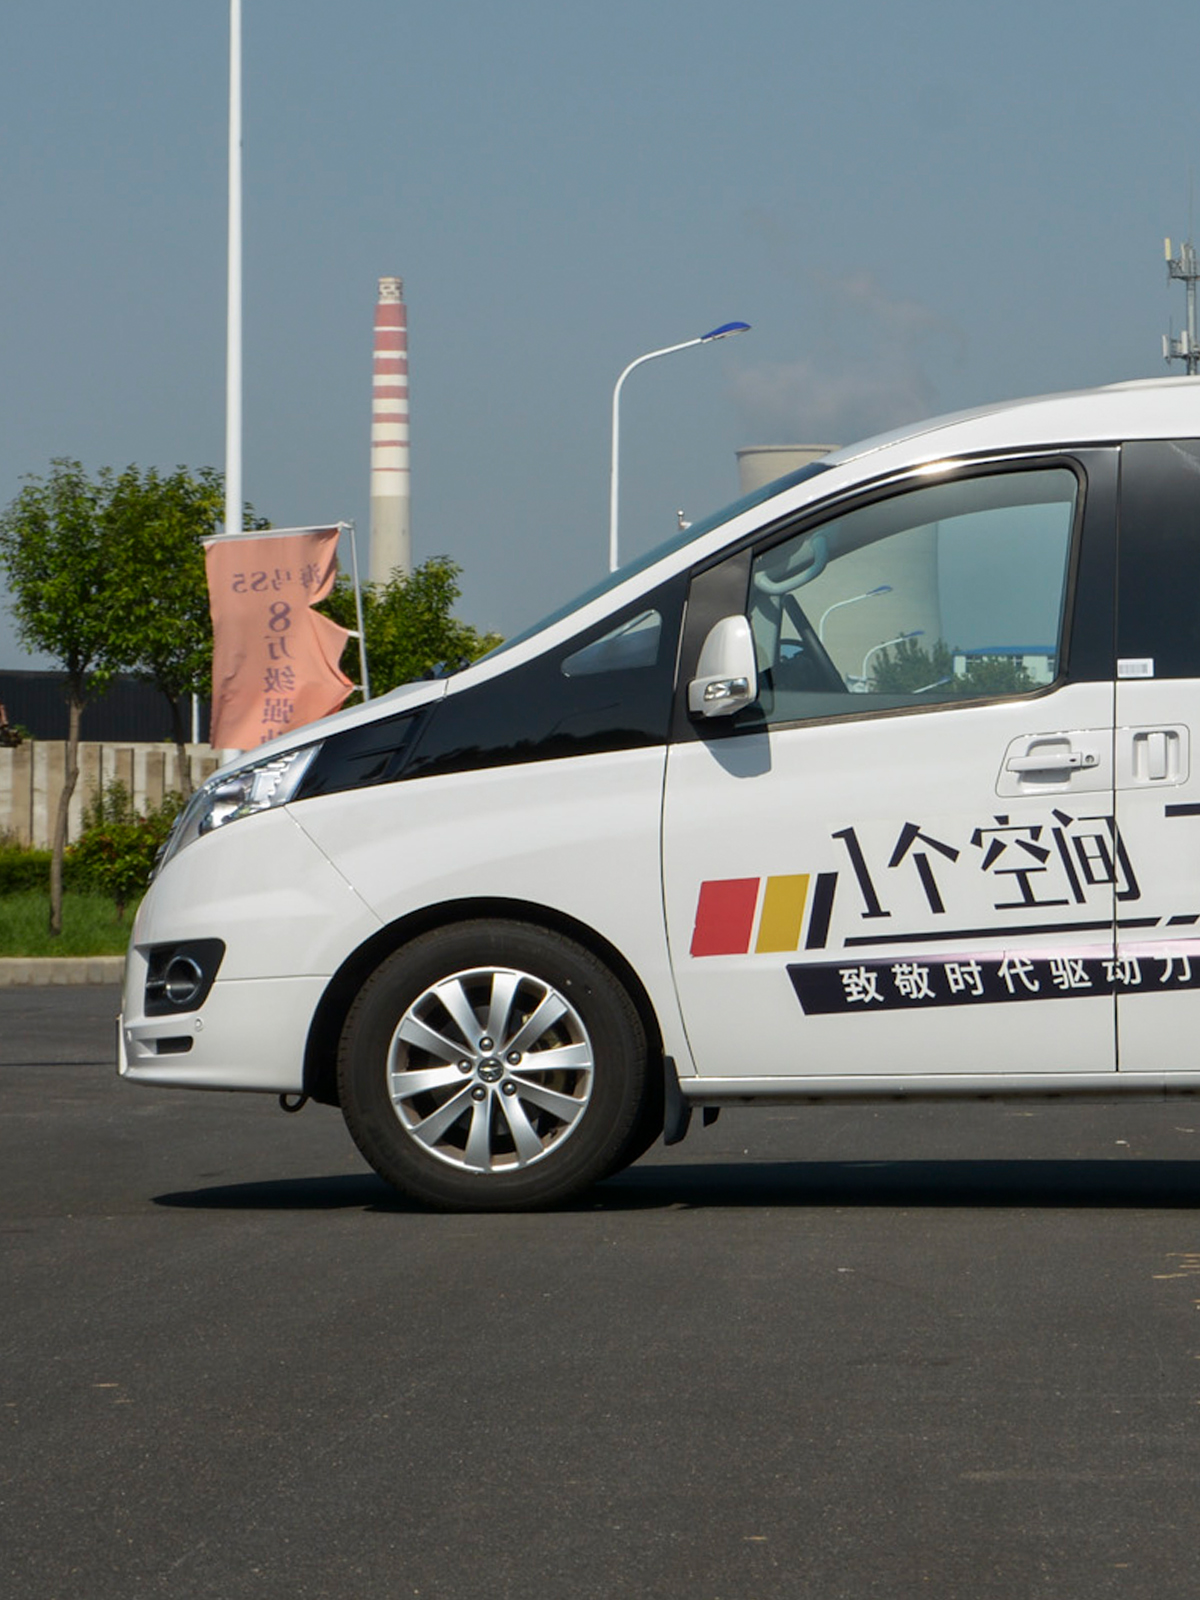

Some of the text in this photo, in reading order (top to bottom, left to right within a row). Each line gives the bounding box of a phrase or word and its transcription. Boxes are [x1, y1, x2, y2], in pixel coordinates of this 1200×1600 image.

[831, 808, 1142, 919] 1个空间
[839, 947, 1194, 1005] 致敬时代驱动力
